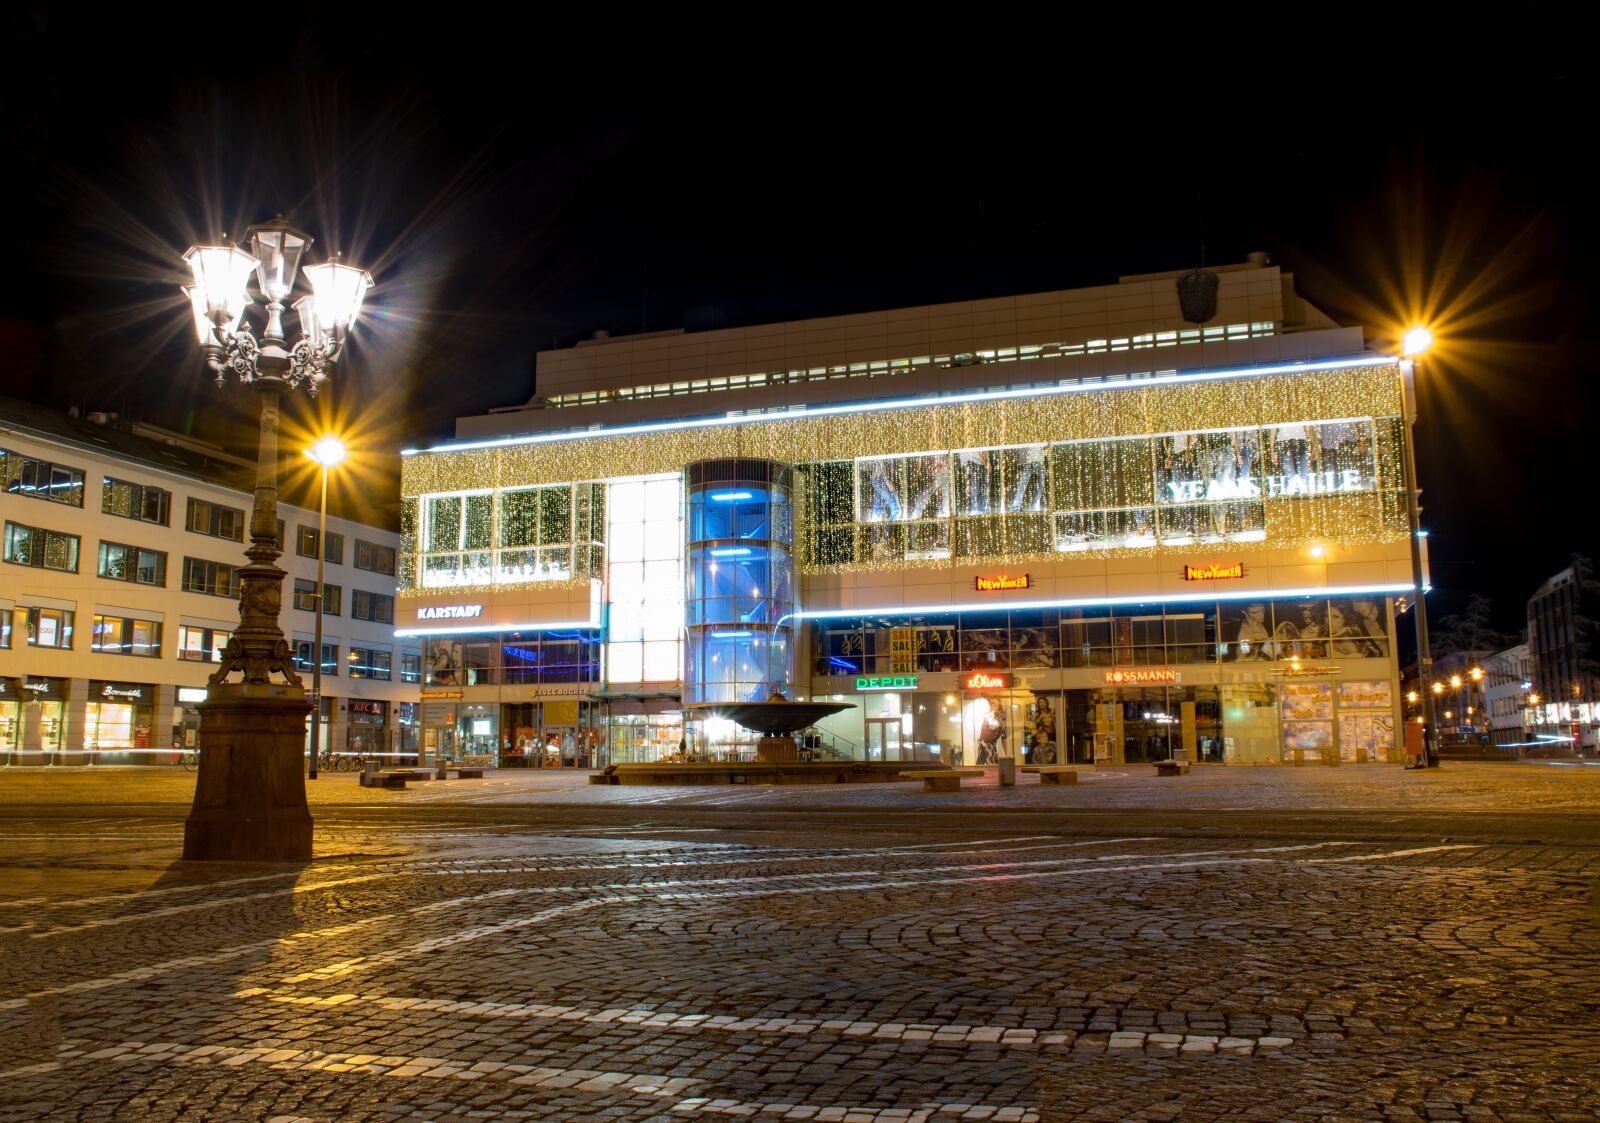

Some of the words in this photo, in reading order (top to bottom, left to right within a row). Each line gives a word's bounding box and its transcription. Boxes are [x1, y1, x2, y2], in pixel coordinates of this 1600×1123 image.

[1267, 469, 1362, 496] HALLE
[417, 604, 482, 619] KARSTADT
[892, 630, 915, 641] SALE
[892, 641, 915, 652] SALE
[892, 652, 916, 663] SALE
[893, 663, 916, 673] SALE
[856, 675, 918, 688] DEPOT
[1105, 670, 1175, 682] ROSSMANN
[354, 703, 370, 712] KFC
